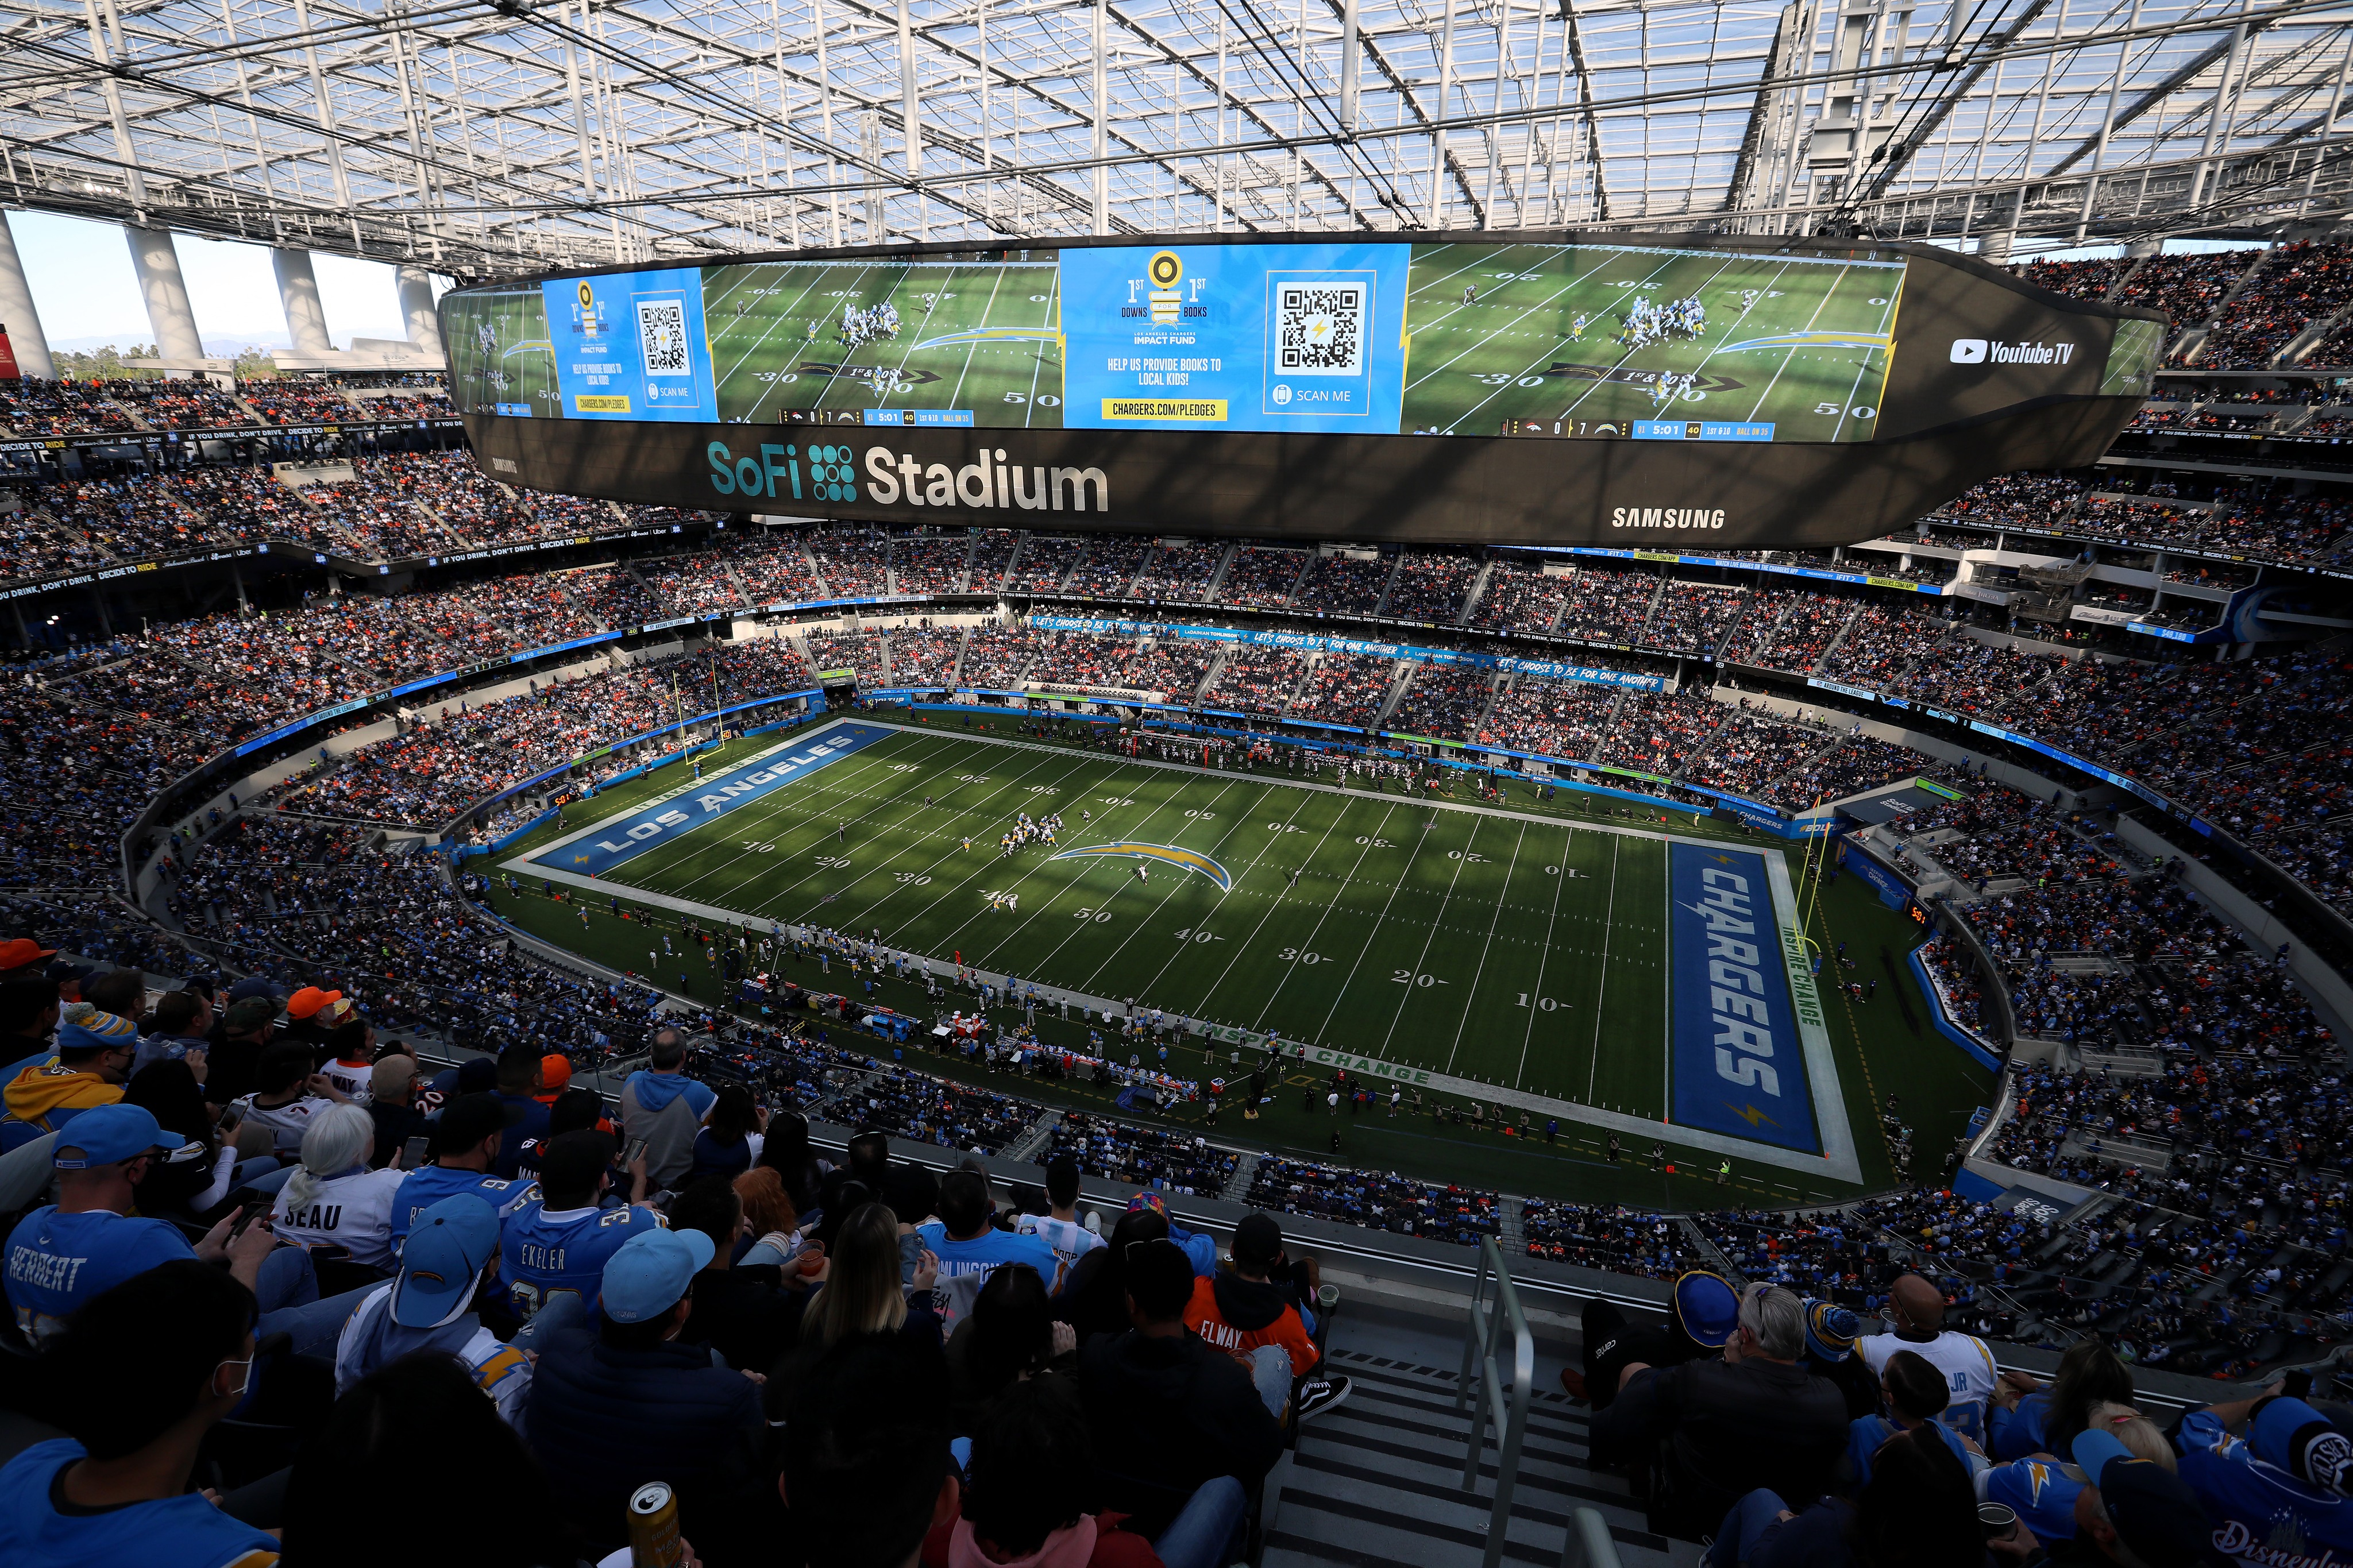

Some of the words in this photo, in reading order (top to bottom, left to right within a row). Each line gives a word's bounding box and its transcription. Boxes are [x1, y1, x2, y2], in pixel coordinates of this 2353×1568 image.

[1128, 279, 1144, 303] 1ST
[1189, 278, 1206, 302] 1ST
[571, 303, 579, 322] 1ST
[596, 301, 605, 320] 1ST
[1122, 307, 1147, 318] DOWNS
[1184, 307, 1207, 317] BOOKS
[1134, 337, 1168, 345] IMPACT
[1170, 337, 1195, 345] FUND
[1991, 341, 2054, 365] YouTube
[2055, 343, 2074, 365] TV
[573, 364, 581, 374] HELP
[582, 364, 587, 373] US
[603, 364, 616, 373] BOOKS
[616, 364, 622, 373] TO
[1108, 358, 1128, 371] HELP
[1130, 358, 1141, 371] US
[1144, 358, 1178, 371] PROVIDE
[1181, 358, 1208, 371] BOOKS
[1210, 358, 1221, 371] TO
[587, 375, 599, 385] LOCAL
[1139, 373, 1164, 385] LOCAL
[1167, 373, 1189, 385] KIDS!
[660, 388, 677, 396] SCAN
[678, 388, 688, 396] ME
[1297, 390, 1328, 401] SCAN
[1332, 391, 1351, 401] ME
[580, 399, 624, 409] CHARGERS.COM/PLEDGES
[1113, 403, 1216, 416] CHARGERS.COM/PLEDGES
[810, 411, 815, 422] 0
[827, 412, 831, 422] 7
[867, 413, 873, 421] Q1
[879, 413, 898, 421] 5:01
[919, 414, 928, 422] 1ST
[1554, 422, 1561, 434] 0
[1580, 422, 1587, 435] 7
[1638, 426, 1645, 434] Q1
[1653, 425, 1679, 435] 5:01
[1688, 426, 1700, 434] 40
[1706, 426, 1717, 434] 1ST
[1737, 427, 1752, 435] BALL
[707, 441, 802, 500] SoFi
[865, 446, 1108, 511] Stadium
[1612, 507, 1725, 529] SAMSUNG
[1638, 553, 1676, 561] CHARGERS.COM/APP
[1769, 565, 1789, 573] CHARGERS
[1872, 578, 1914, 589] CHARGERS.COM/APP
[1254, 632, 1274, 643] LET'S
[1275, 635, 1306, 646] CHOOSE
[1306, 638, 1316, 646] TO
[1518, 661, 1550, 673] CHOOSE
[1554, 665, 1563, 674] TO
[1564, 667, 1577, 676] BE
[1580, 669, 1598, 678] FOR
[1600, 672, 1615, 682] ONE
[1619, 674, 1658, 688] ANOTHER
[376, 693, 388, 701] 5:01
[1823, 683, 1839, 691] AROUND
[1849, 688, 1864, 697] LEAGUE
[1003, 741, 1060, 751] INSPIRE
[1065, 750, 1126, 761] CHANGE
[658, 782, 696, 804] TAKES
[706, 770, 728, 783] ALL
[730, 761, 747, 771] OF
[751, 753, 767, 762] US
[555, 793, 570, 806] 5:01
[595, 809, 689, 853] LOS
[695, 735, 854, 813] ANGELES
[1880, 800, 1908, 814] Stadium
[1887, 798, 1907, 808] SoFi
[1739, 812, 1783, 829] CHARGERS
[822, 855, 851, 870] 20
[900, 872, 932, 886] 30
[1869, 867, 1884, 879] INSPIRE
[1073, 907, 1112, 923] 50
[1911, 906, 1926, 925] 5:01
[1174, 928, 1213, 943] 40
[1278, 947, 1321, 965] 30
[1781, 926, 1811, 976] INSPIRE
[1391, 968, 1435, 988] 20
[1676, 868, 1781, 1098] CHARGERS
[1514, 992, 1558, 1013] 10
[1794, 973, 1822, 1028] CHANGE
[1316, 1051, 1430, 1084] CHANGE
[415, 1091, 445, 1116] 20
[284, 1204, 342, 1231] SEAU
[522, 1242, 565, 1270] EKELER
[9, 1245, 87, 1292] HERBERT
[1200, 1320, 1243, 1349] ELWAY
[1951, 1372, 1968, 1392] JR
